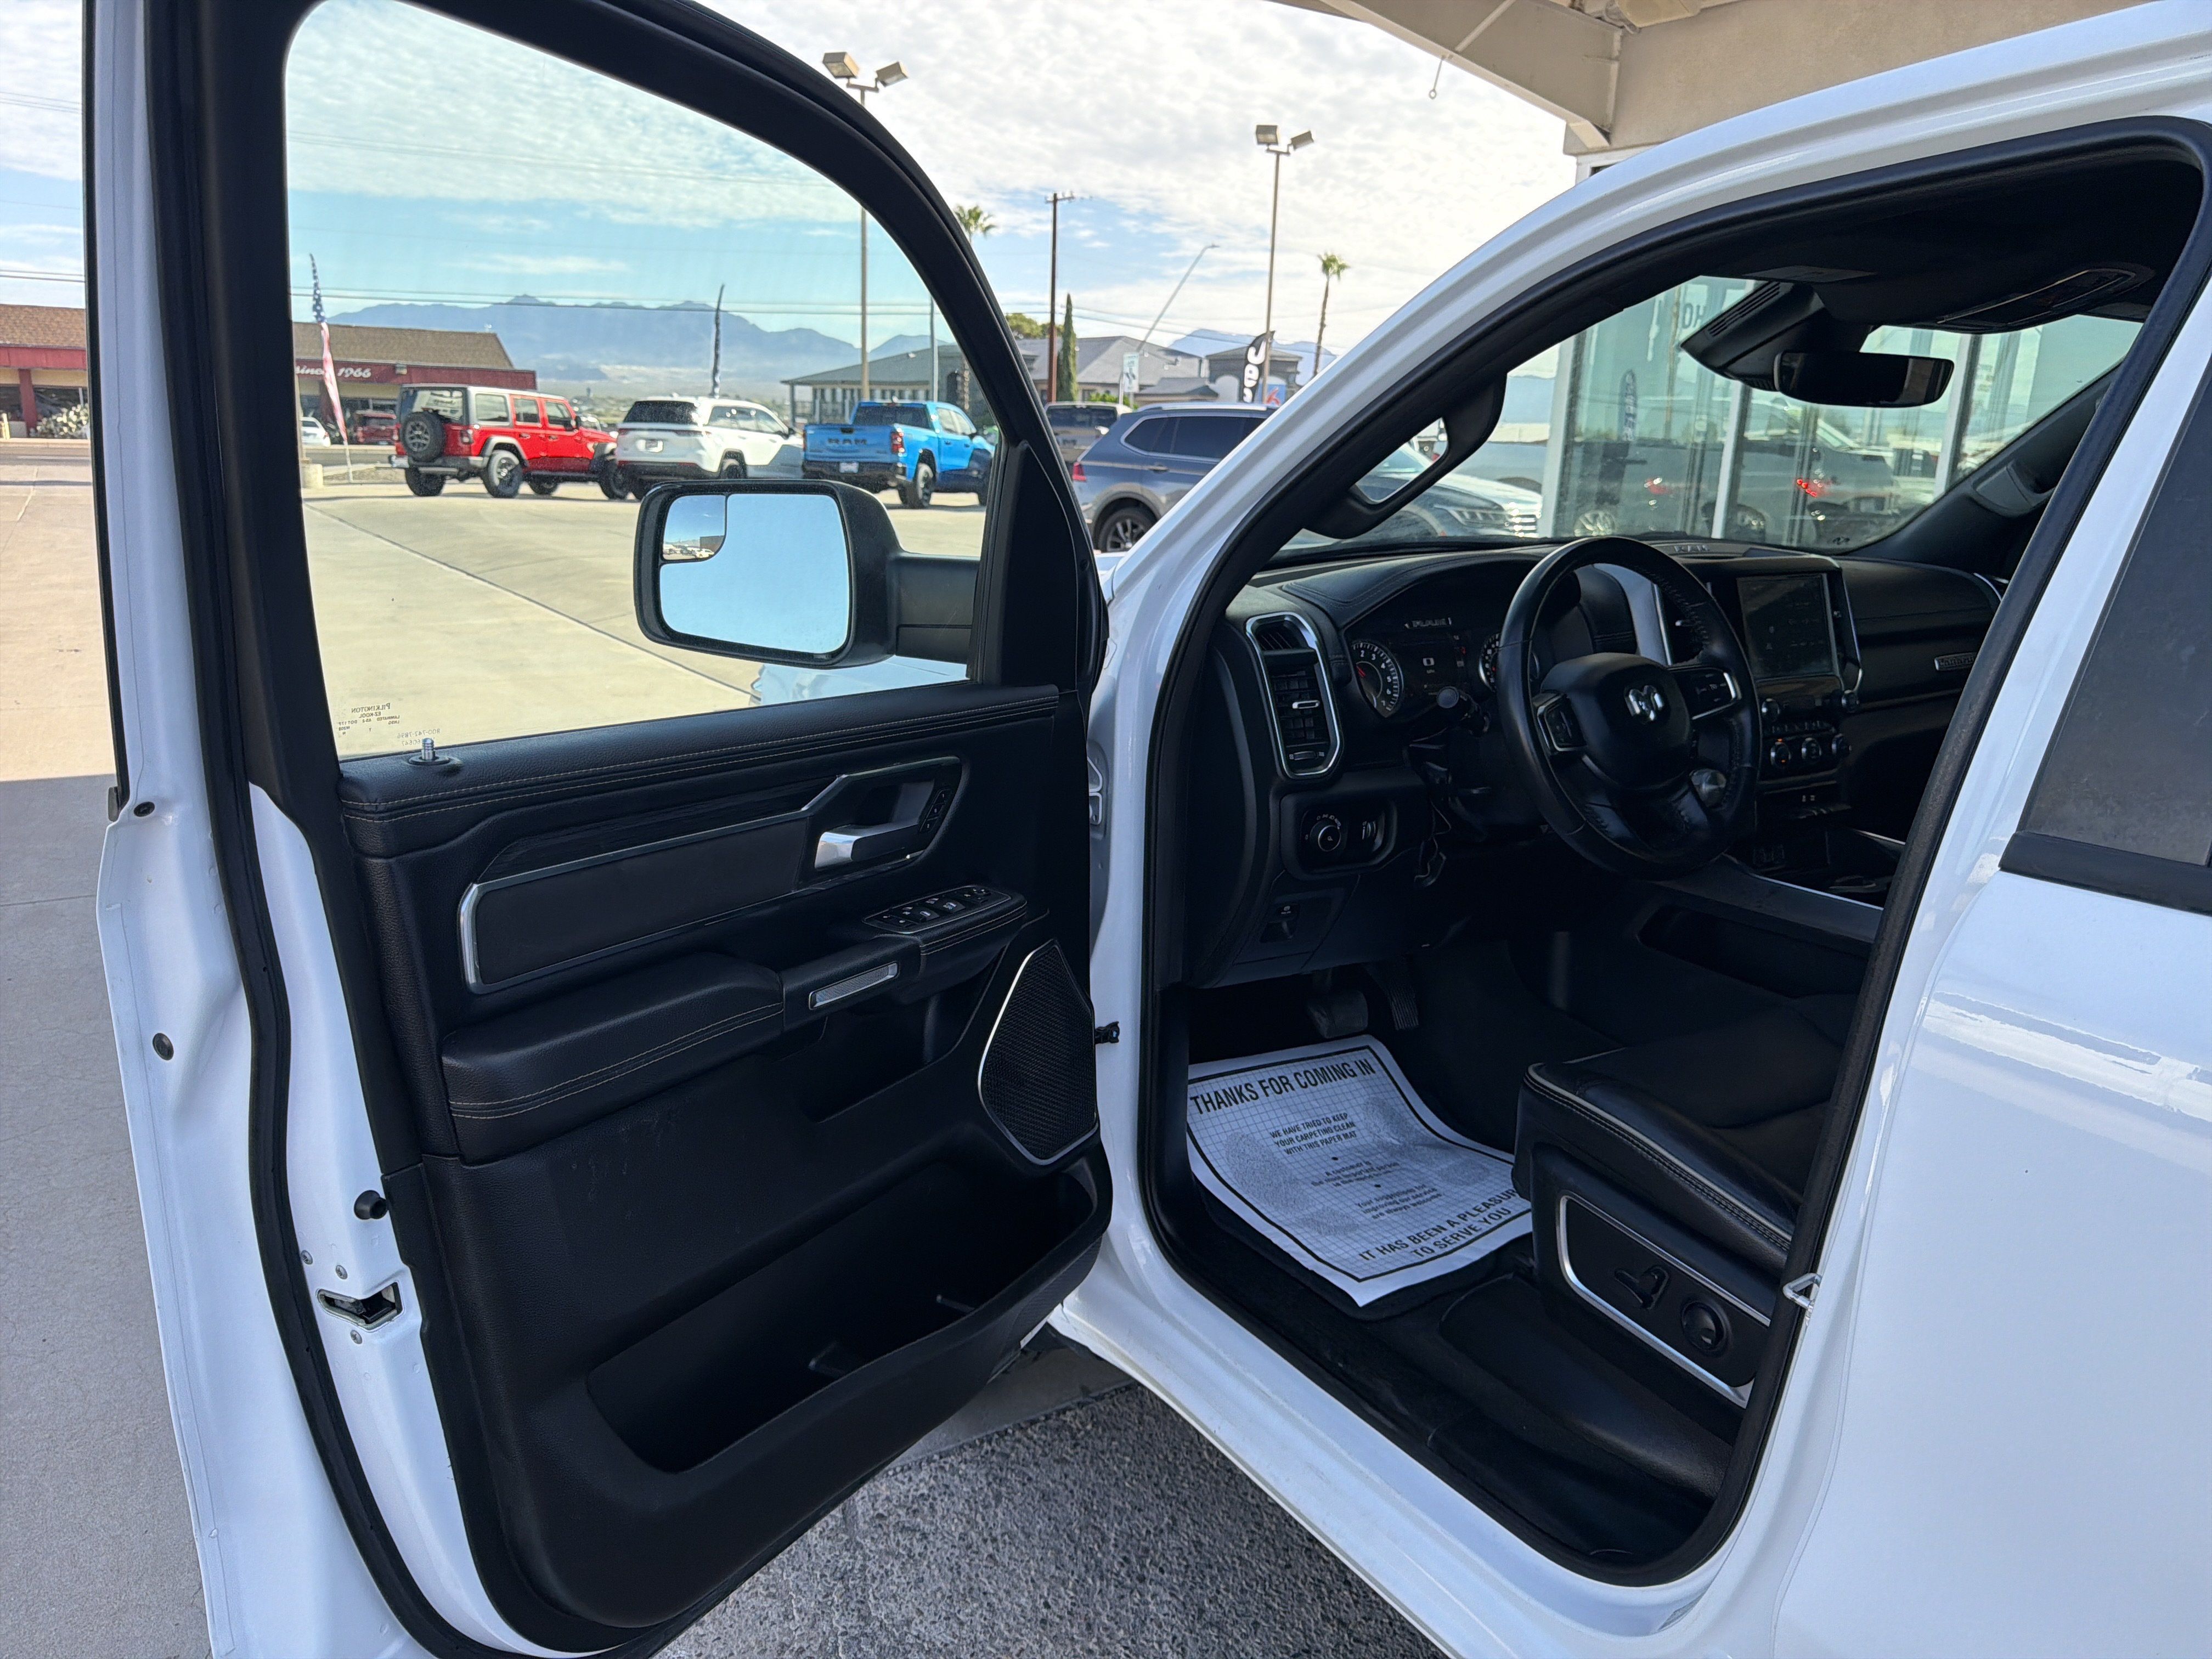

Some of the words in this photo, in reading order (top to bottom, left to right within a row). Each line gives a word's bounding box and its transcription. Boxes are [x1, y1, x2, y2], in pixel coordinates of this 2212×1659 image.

[337, 367, 371, 377] 1966
[1190, 1083, 1259, 1114] THANKS
[1258, 1075, 1295, 1097] FOR
[1294, 1063, 1357, 1089] COMING
[1355, 1058, 1375, 1075] IN
[1269, 1130, 1282, 1138] WE
[1282, 1124, 1302, 1135] HAVE
[1301, 1119, 1322, 1130] TRIED
[1321, 1116, 1332, 1125] TO
[1331, 1112, 1348, 1122] KEEP
[1274, 1137, 1295, 1147] YOUR
[1295, 1126, 1334, 1142] CARPETING
[1333, 1121, 1356, 1132] CLEAN
[1284, 1145, 1304, 1155] WITH
[1304, 1141, 1320, 1150] THIS
[1319, 1135, 1342, 1146] PAPER
[1342, 1131, 1357, 1140] MAT
[1358, 1250, 1376, 1261] IT
[1375, 1239, 1409, 1255] HAS
[1407, 1224, 1448, 1245] BEEN
[1446, 1218, 1461, 1228] A
[1412, 1245, 1435, 1257] TO
[1432, 1223, 1482, 1250] SERVE
[1477, 1207, 1511, 1225] YOU
